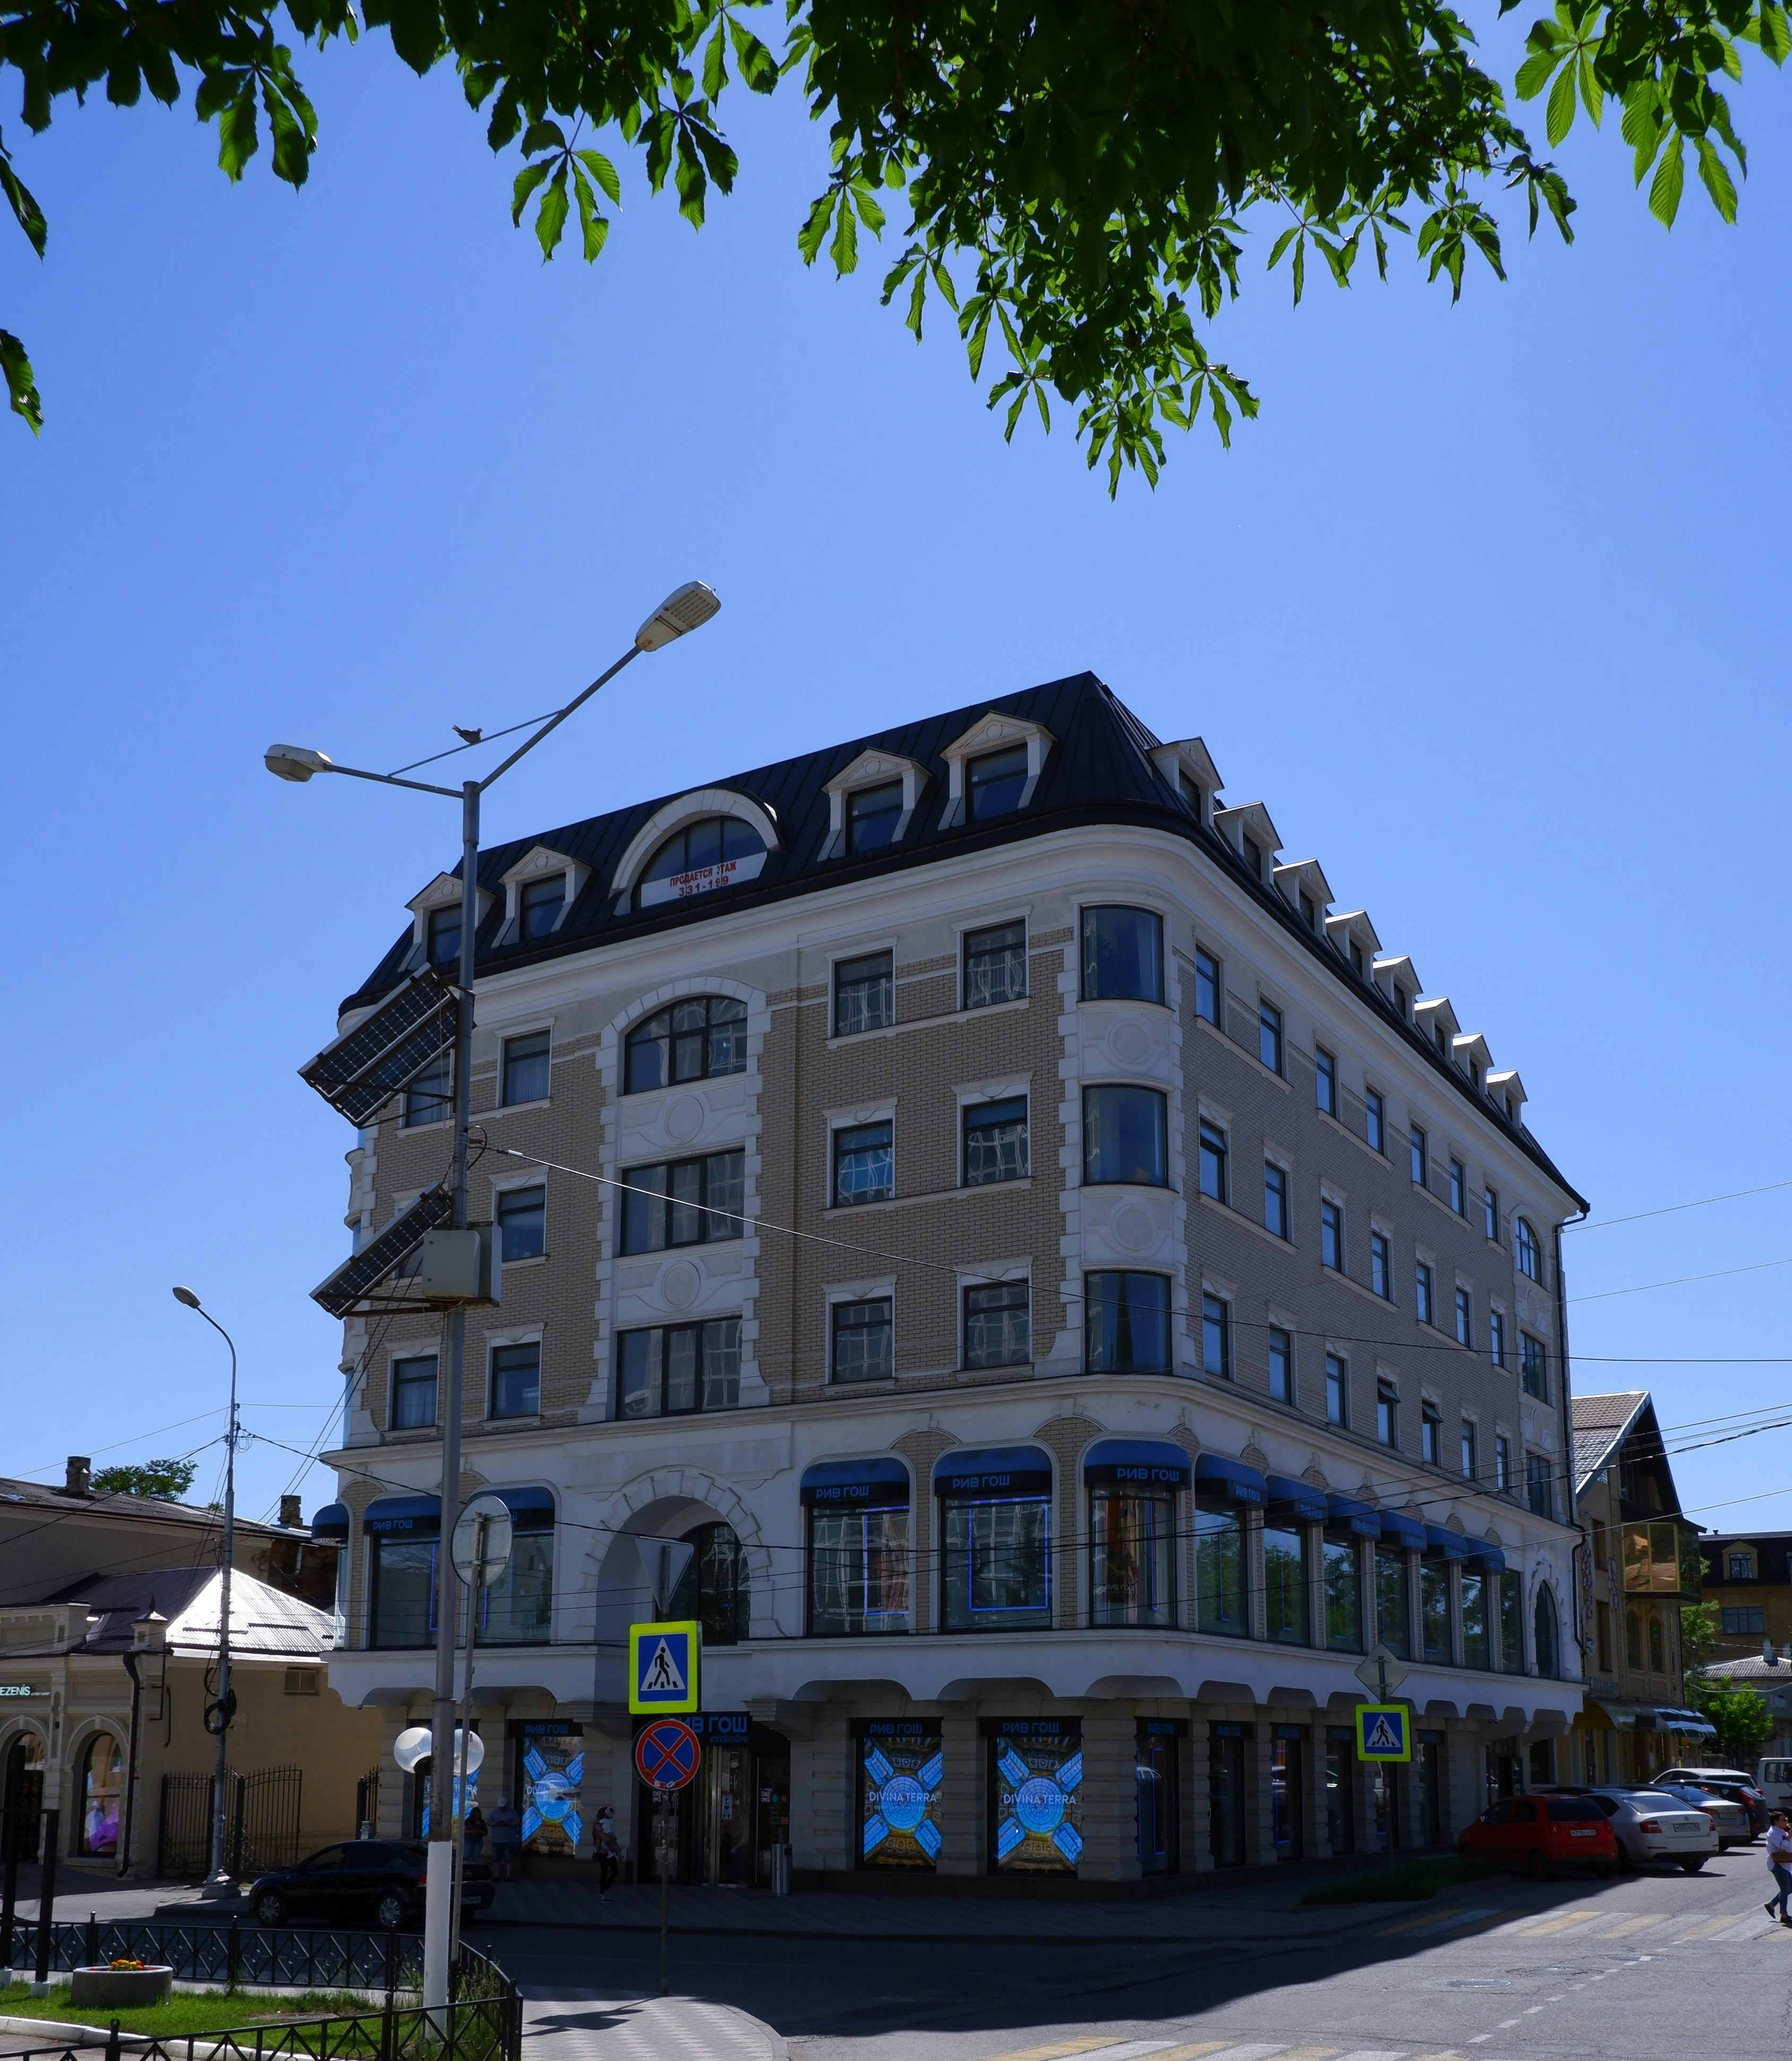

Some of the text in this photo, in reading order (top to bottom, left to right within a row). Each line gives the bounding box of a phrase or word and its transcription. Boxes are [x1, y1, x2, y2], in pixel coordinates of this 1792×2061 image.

[670, 868, 713, 887] ПРОДАЕТСЯ
[679, 876, 729, 897] 331-199
[1117, 1468, 1179, 1481] РИВ ГОШ
[952, 1474, 1010, 1489] РИВ ГОШ
[816, 1486, 869, 1499] РИВ ГОШ
[1236, 1485, 1261, 1502] РИВ ГОШ
[373, 1519, 413, 1531] РИВ ГОШ
[0, 1684, 30, 1696] EZENIS
[525, 1724, 569, 1734] РИВ ГОШ
[669, 1716, 747, 1733] ИВ ГОШ
[869, 1723, 923, 1734] РИВ ГОШ
[1002, 1722, 1059, 1733] РИВ ГОШ
[710, 1734, 749, 1743] exclusive
[869, 1791, 937, 1803] DIVINA TERRA
[1003, 1793, 1076, 1805] DIVINA TERRA
